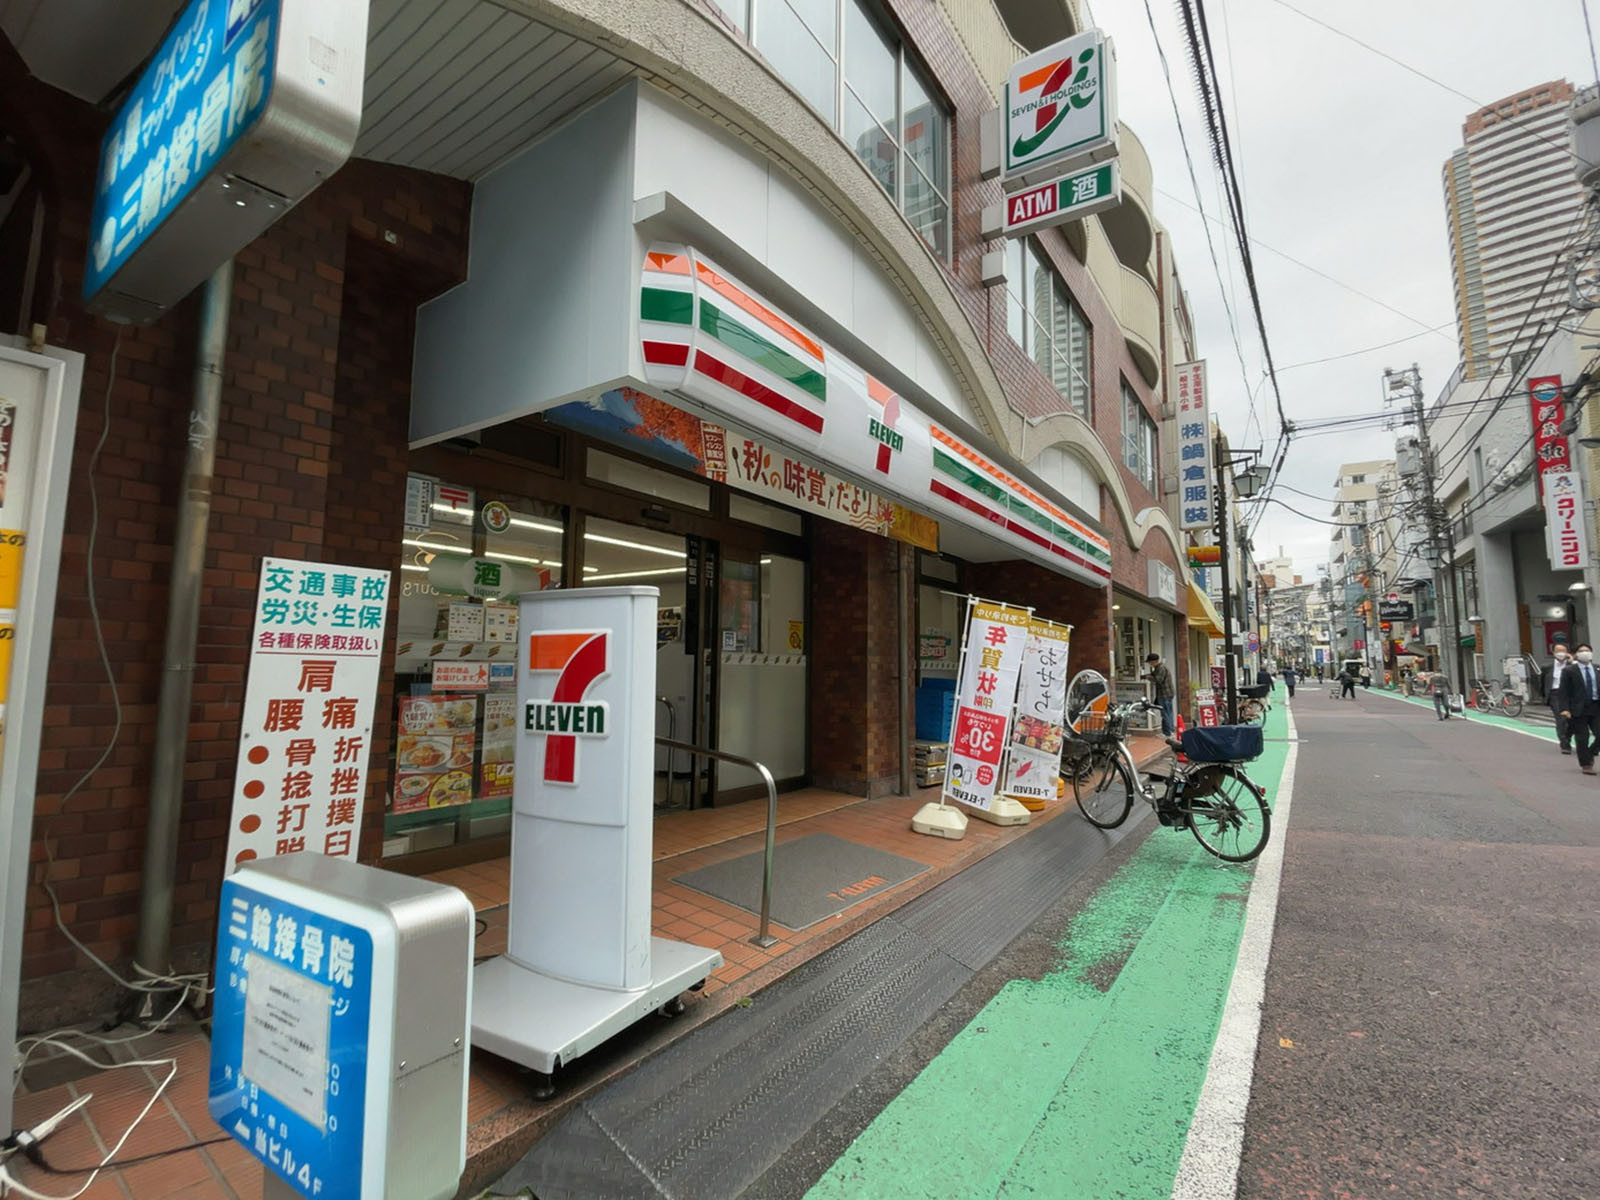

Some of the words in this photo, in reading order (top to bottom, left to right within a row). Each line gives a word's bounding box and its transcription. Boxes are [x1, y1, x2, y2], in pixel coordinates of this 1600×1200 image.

[1050, 77, 1097, 102] HOLDINGS
[1072, 172, 1098, 204] 酒
[1012, 188, 1052, 222] ATM
[265, 567, 387, 601] 交通事故
[474, 561, 502, 587] 酒
[474, 586, 501, 598] liquor
[261, 598, 383, 630] 労災・生保
[259, 632, 379, 651] 各種保険取扱い
[297, 659, 337, 693] 肩
[264, 696, 358, 733] 腰痛
[285, 736, 363, 768] 骨折
[281, 768, 360, 801] 捻挫
[276, 798, 357, 835] 打撲
[229, 898, 356, 989] 三輪接骨院
